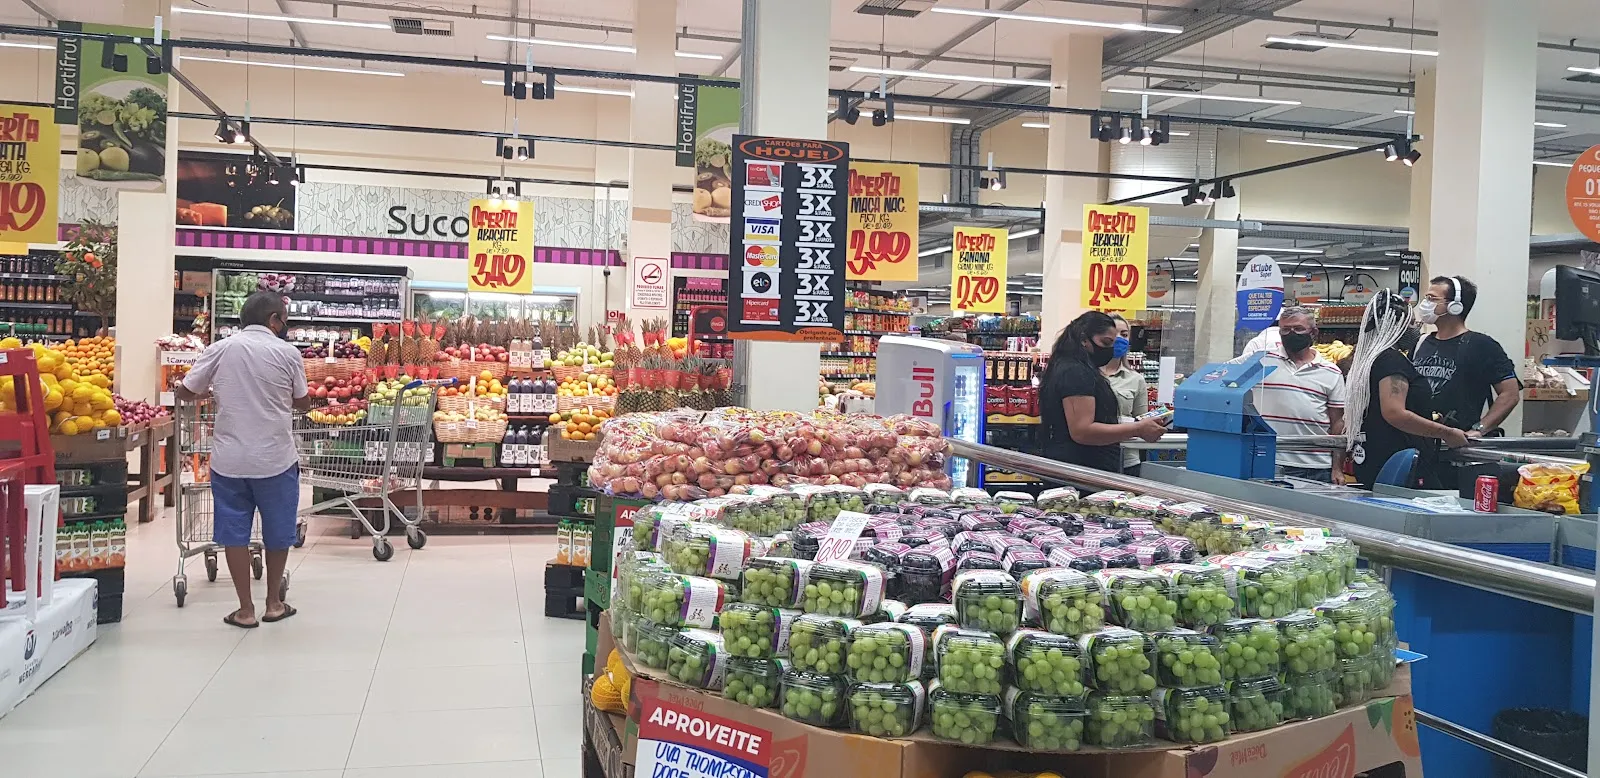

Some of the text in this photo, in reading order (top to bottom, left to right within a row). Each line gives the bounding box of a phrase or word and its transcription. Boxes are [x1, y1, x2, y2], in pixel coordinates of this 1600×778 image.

[57, 38, 77, 109] Hortifrut
[755, 146, 829, 160] HOJE!
[765, 139, 823, 149] CARTÕES PARA
[800, 166, 834, 188] 3X
[848, 168, 900, 196] OFERTA
[798, 193, 832, 215] 3X
[471, 205, 517, 229] OFERTA
[1087, 209, 1136, 233] OFERTA
[477, 228, 517, 242] ABACATE
[751, 225, 775, 234] VISA
[798, 221, 832, 241] 3X
[956, 231, 996, 252] OFERTA
[746, 251, 778, 261] MasterCard
[797, 247, 831, 269] 3X
[959, 251, 990, 263] BANANA
[752, 277, 769, 287] elo
[796, 273, 830, 295] 3X
[1400, 265, 1420, 287] aqui!
[795, 300, 828, 322] 3X
[912, 367, 935, 417] Bull
[648, 707, 762, 755] APROVEITE
[655, 742, 681, 764] UVA
